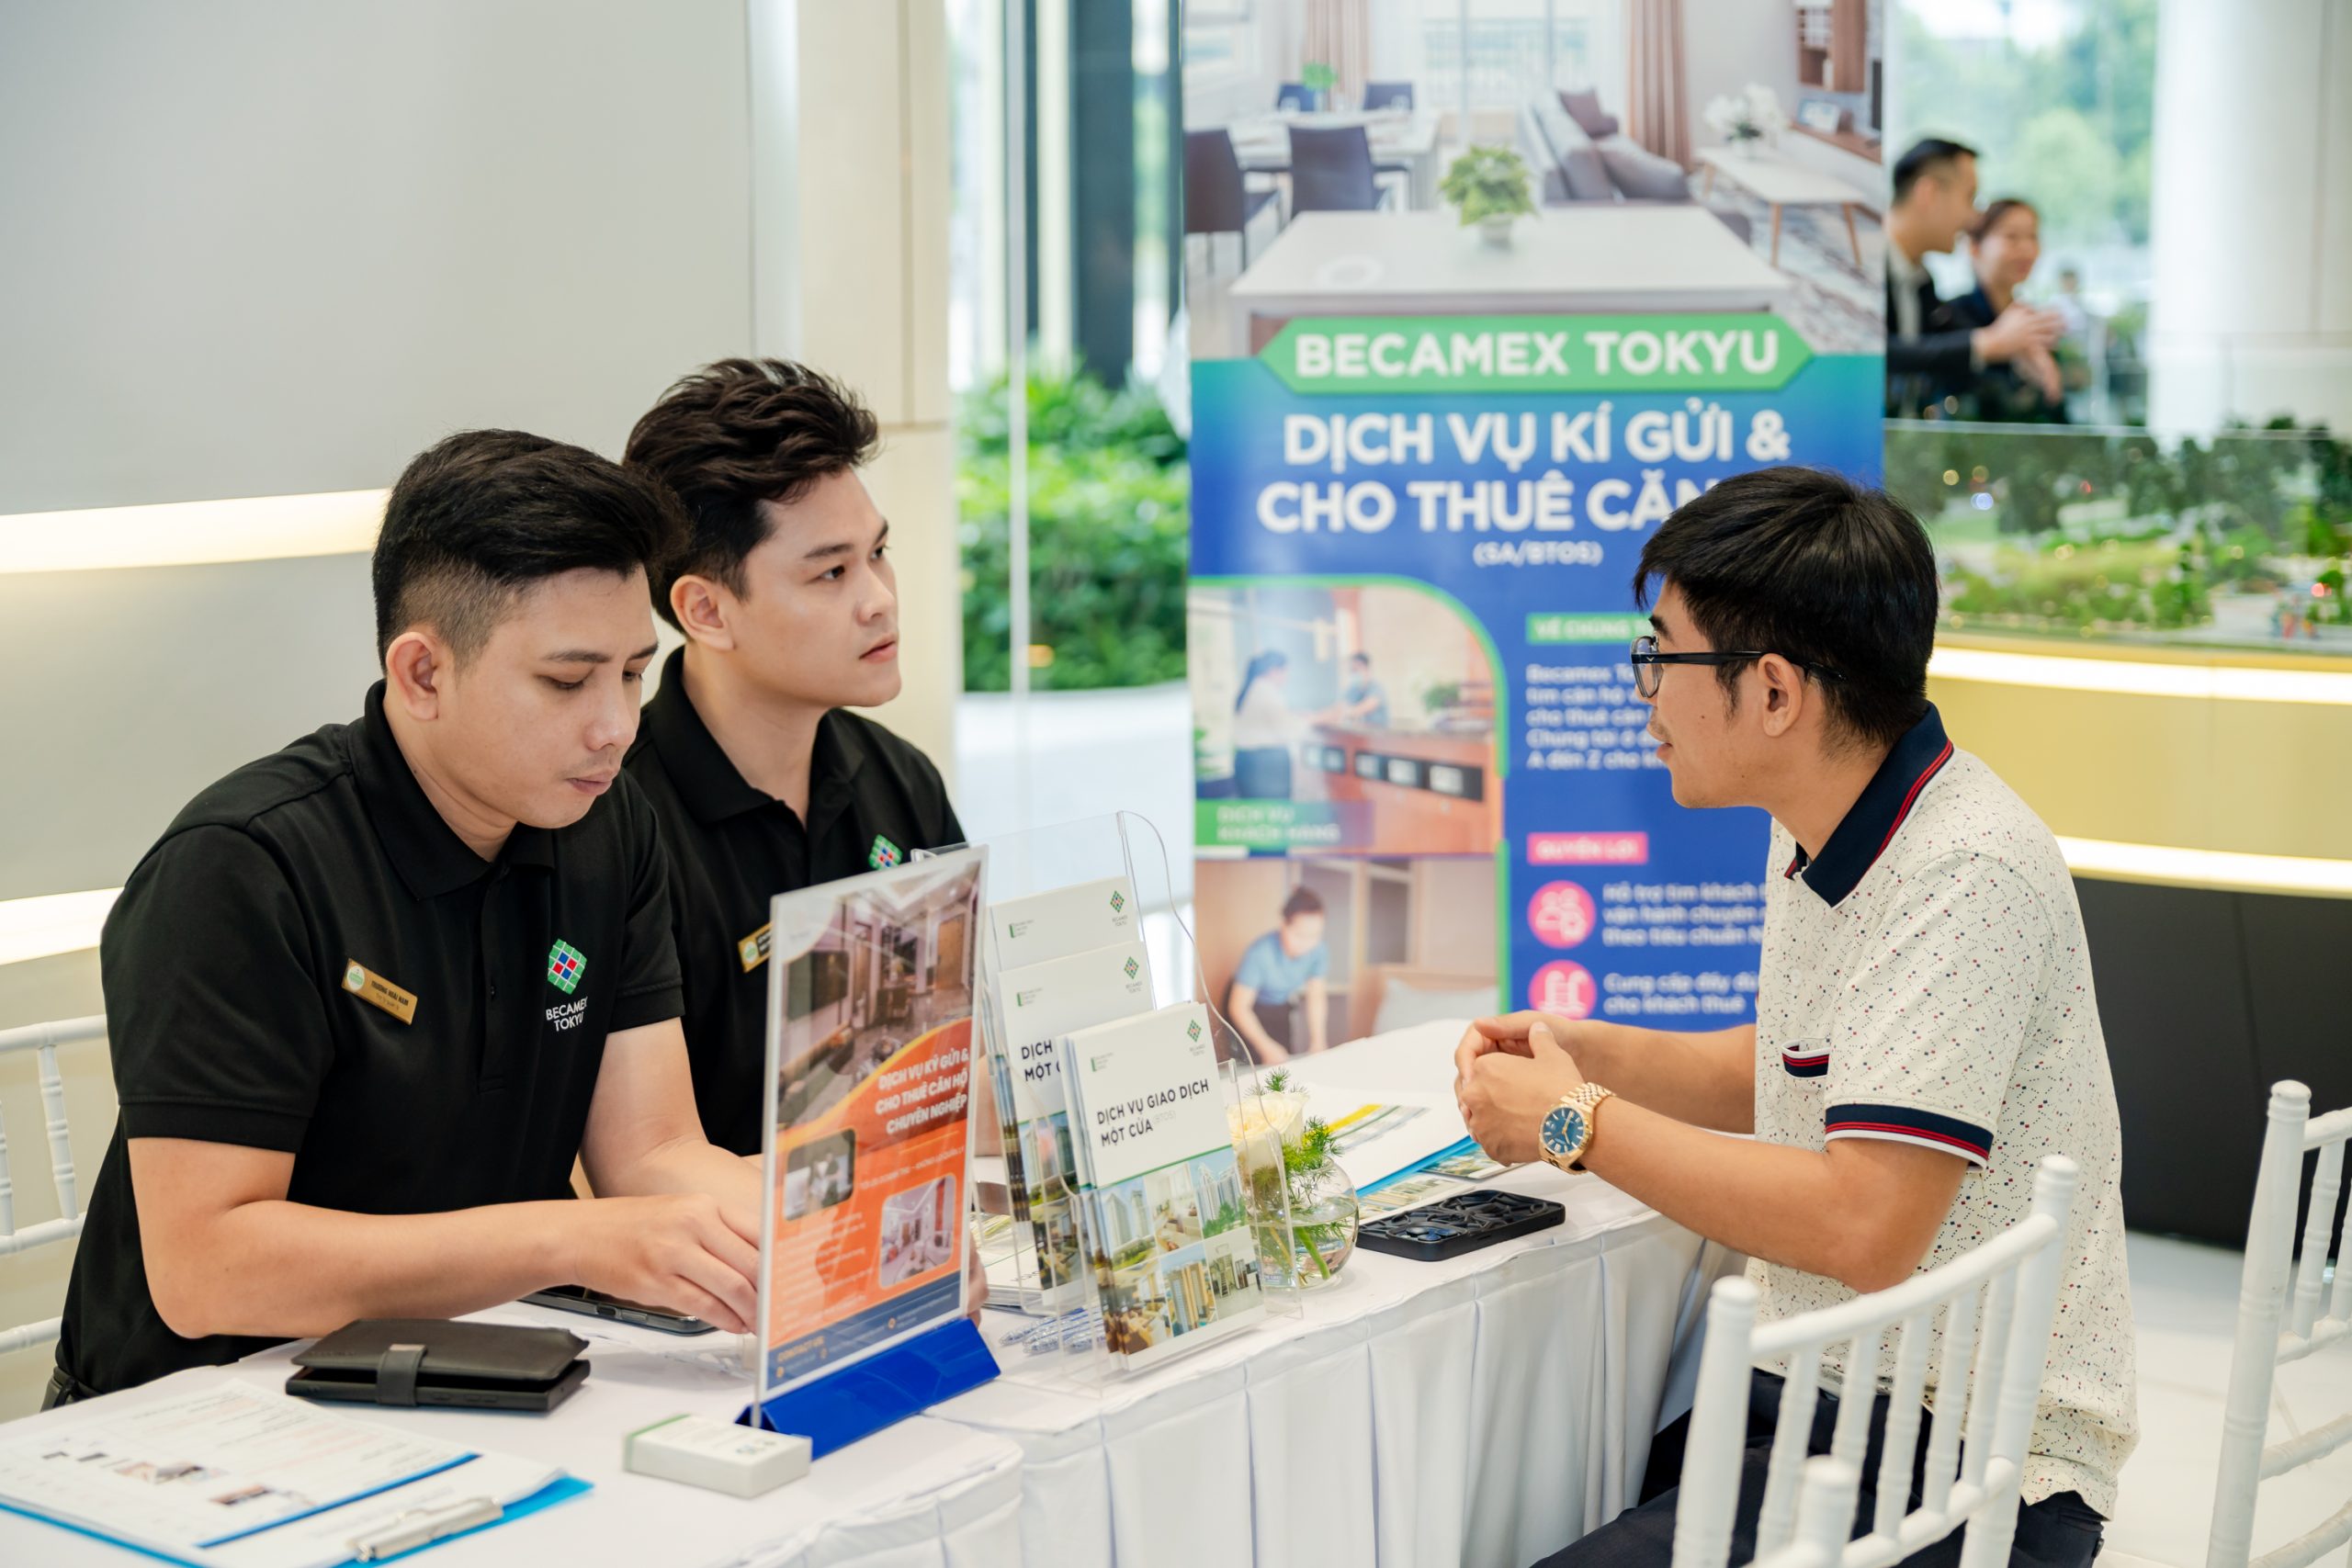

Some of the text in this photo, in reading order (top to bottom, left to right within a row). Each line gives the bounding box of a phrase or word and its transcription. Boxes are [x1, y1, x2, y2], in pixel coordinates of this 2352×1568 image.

[1295, 331, 1779, 377] BECAMEX TOKYU
[1284, 396, 1791, 473] DỊCH VỤ KÍ GỬI &
[1257, 479, 1396, 534] CHO
[1407, 470, 1575, 532] THUÊ
[554, 1011, 583, 1032] TOKYU
[1021, 1039, 1052, 1060] DỊCH
[1024, 1062, 1051, 1082] MỘT
[1097, 1078, 1209, 1125] DỊCH VỤ GIAO DỊCH
[1101, 1126, 1125, 1147] MỘT
